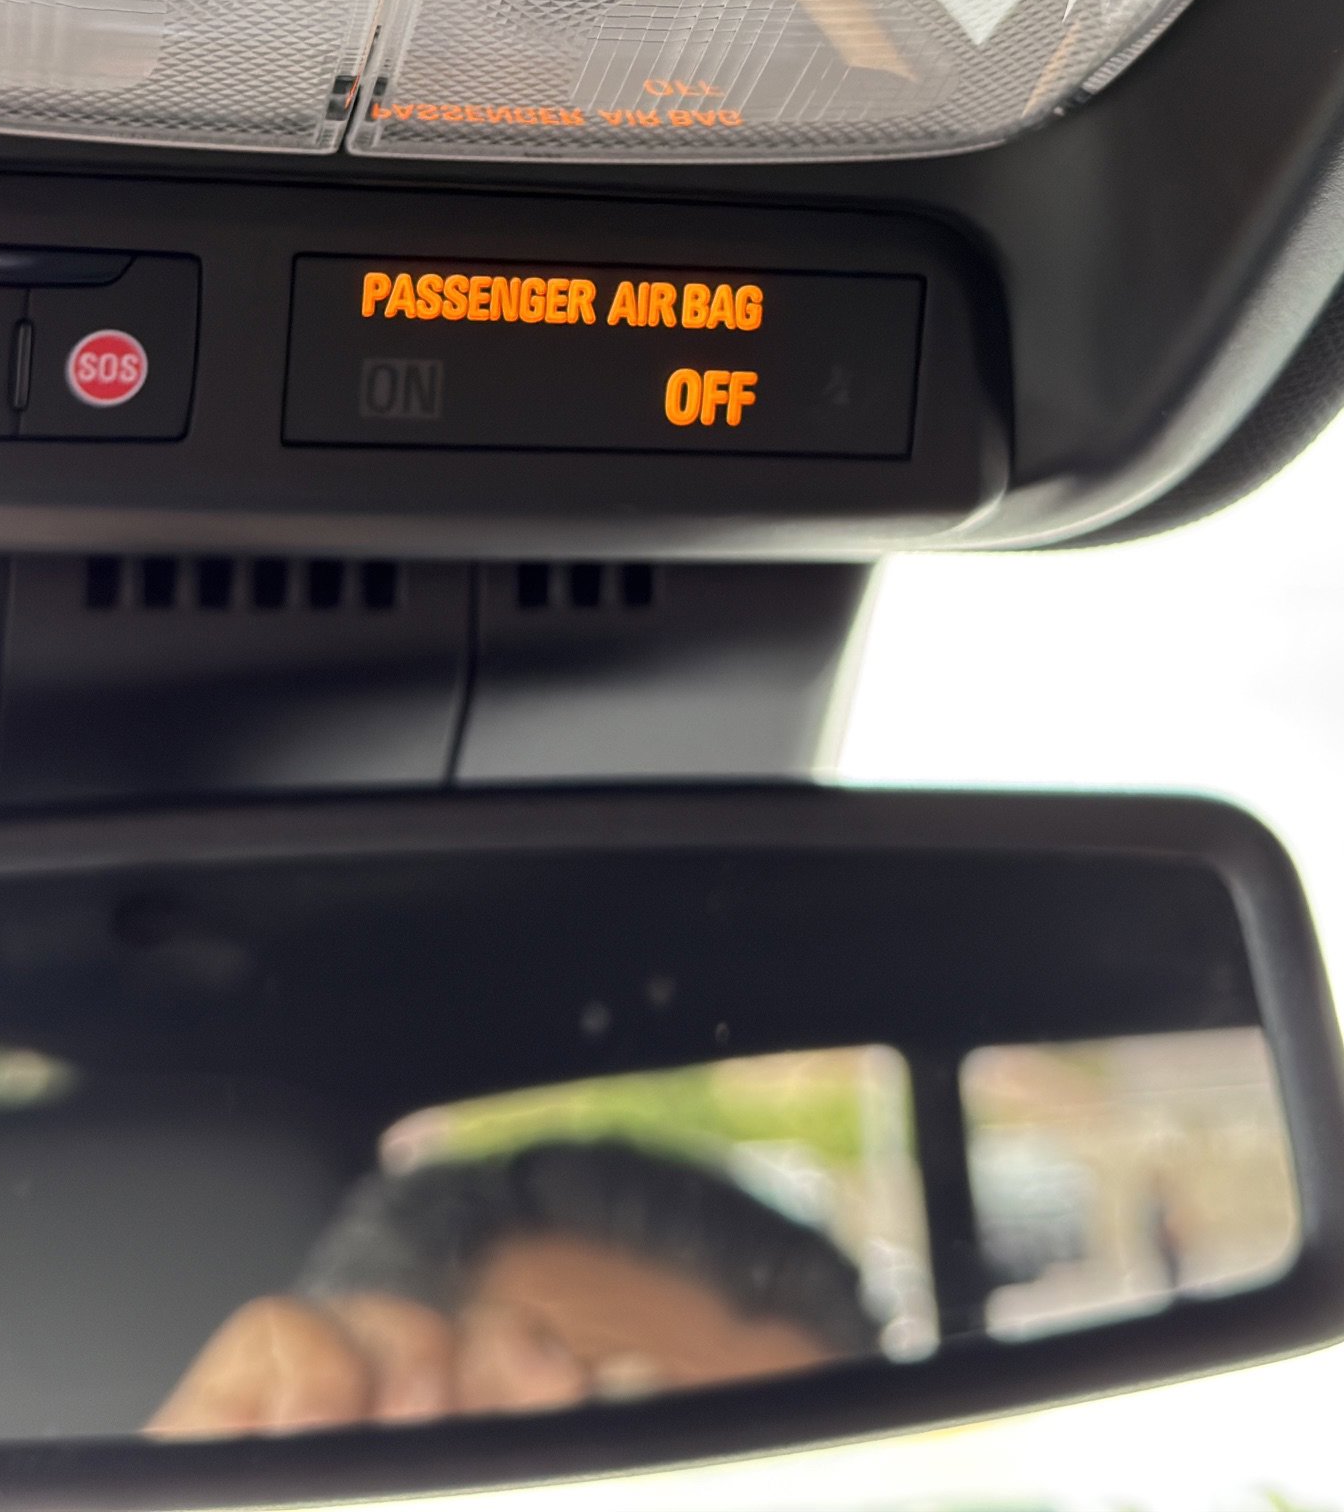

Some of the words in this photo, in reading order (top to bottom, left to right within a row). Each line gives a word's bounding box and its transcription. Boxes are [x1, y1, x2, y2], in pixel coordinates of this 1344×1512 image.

[361, 272, 597, 326] PASSENGER
[77, 350, 140, 384] SOS
[366, 364, 436, 414] ON
[664, 367, 759, 427] OFF
